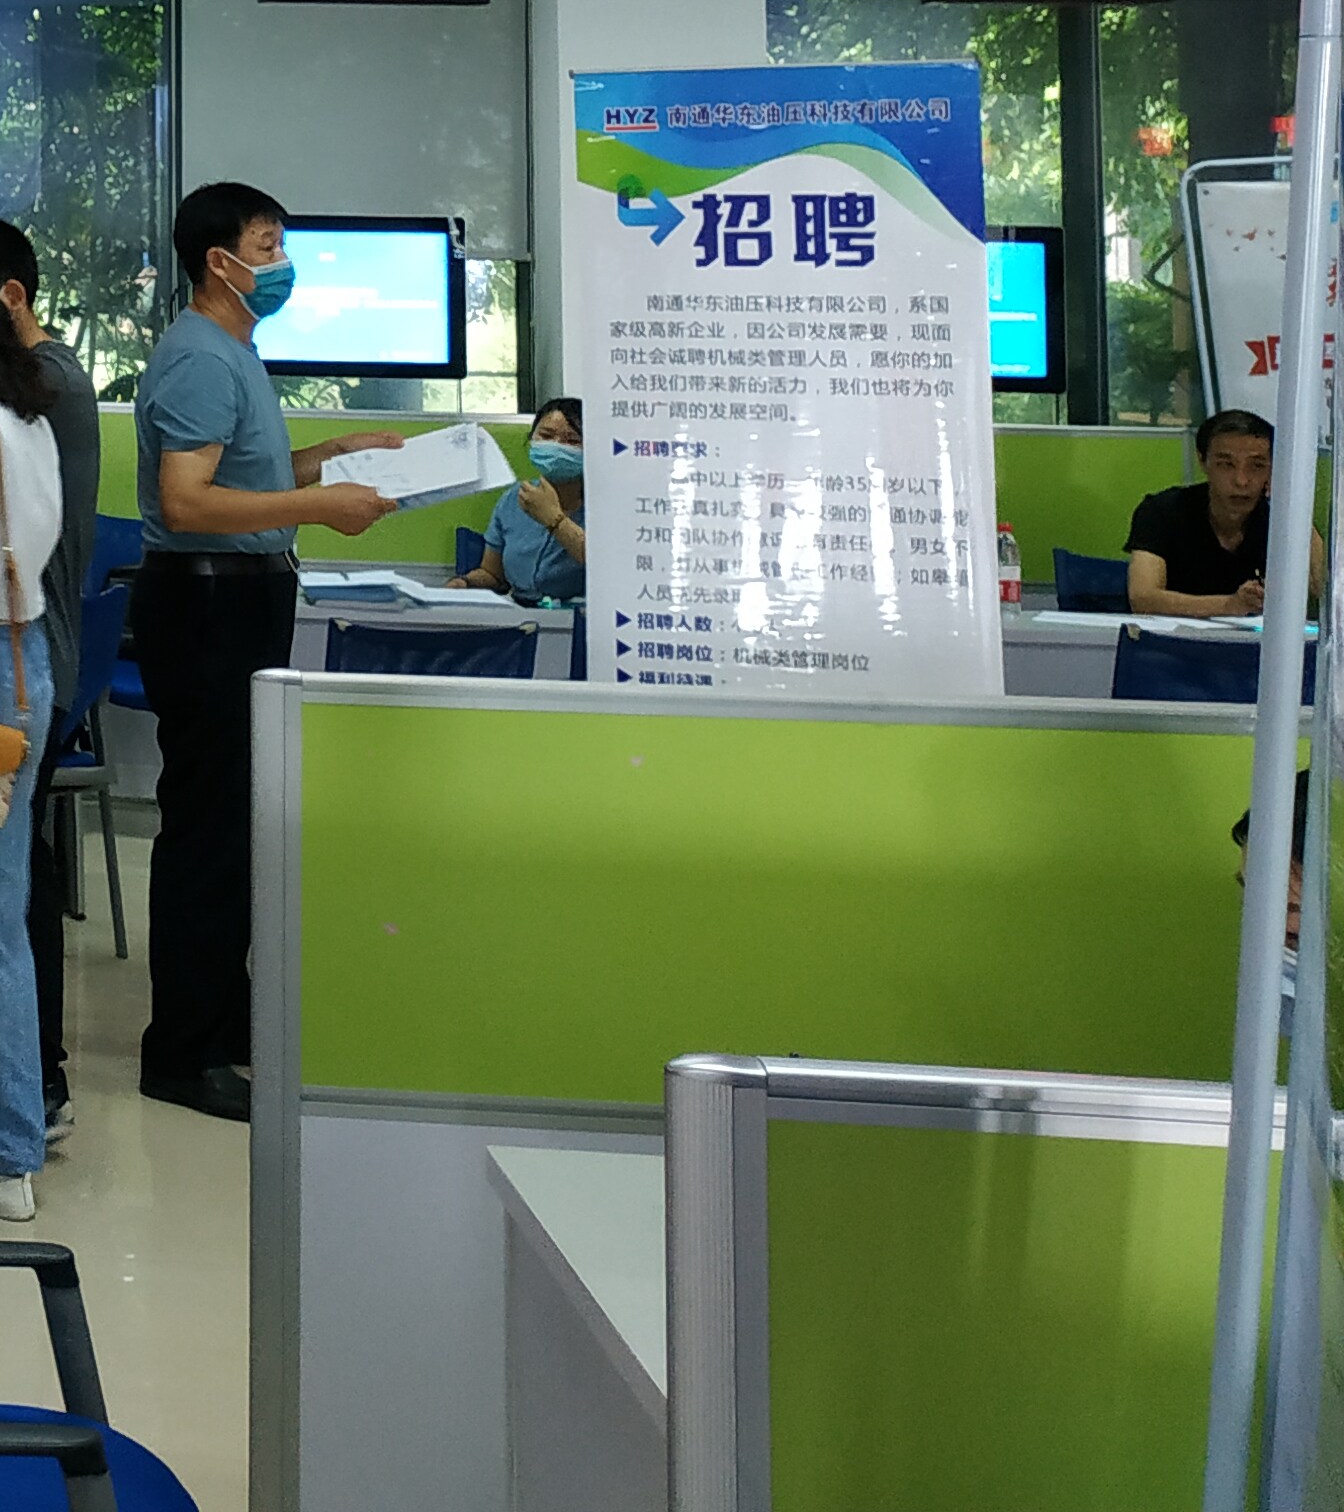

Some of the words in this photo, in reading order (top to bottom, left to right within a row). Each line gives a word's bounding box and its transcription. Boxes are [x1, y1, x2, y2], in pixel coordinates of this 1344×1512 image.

[605, 107, 658, 126] HYZ
[667, 97, 951, 127] 南通华东油压科技有限公司
[692, 192, 877, 269] 招聘
